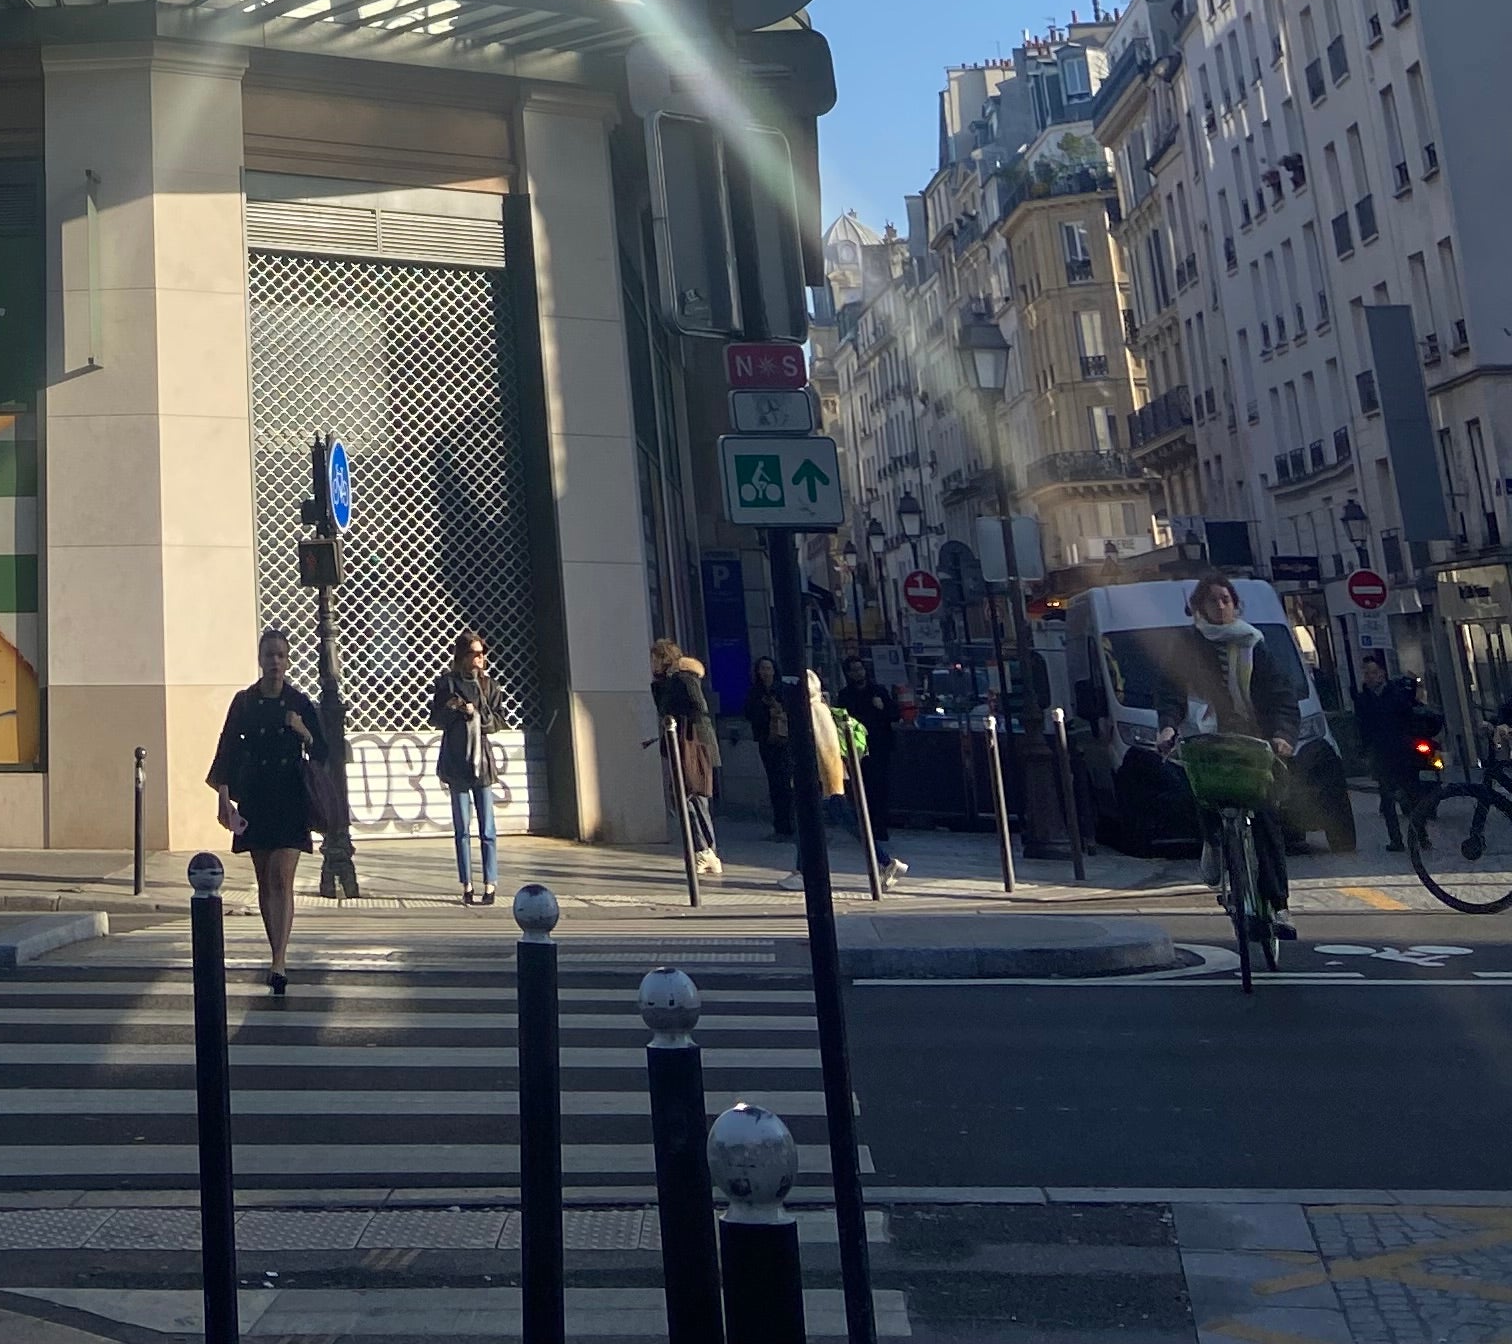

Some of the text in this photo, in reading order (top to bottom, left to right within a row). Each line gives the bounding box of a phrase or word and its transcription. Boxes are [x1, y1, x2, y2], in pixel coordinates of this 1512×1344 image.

[735, 355, 798, 377] N S
[711, 564, 730, 589] P
